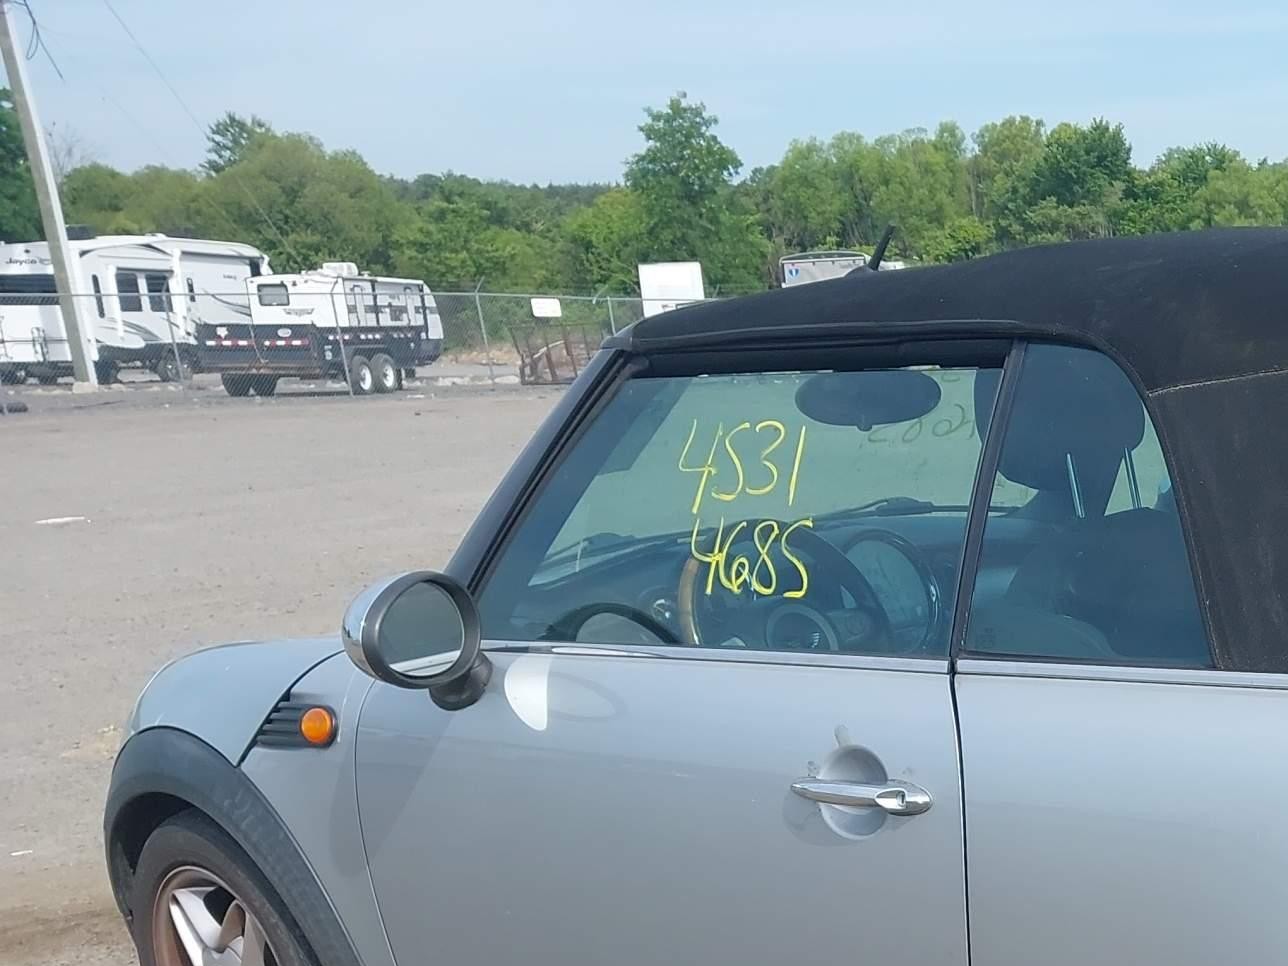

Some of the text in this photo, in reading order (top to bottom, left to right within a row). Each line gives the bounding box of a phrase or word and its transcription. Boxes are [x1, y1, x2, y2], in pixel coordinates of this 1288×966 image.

[5, 257, 37, 266] Jayco
[677, 418, 807, 515] 4531
[690, 516, 814, 600] 4685
